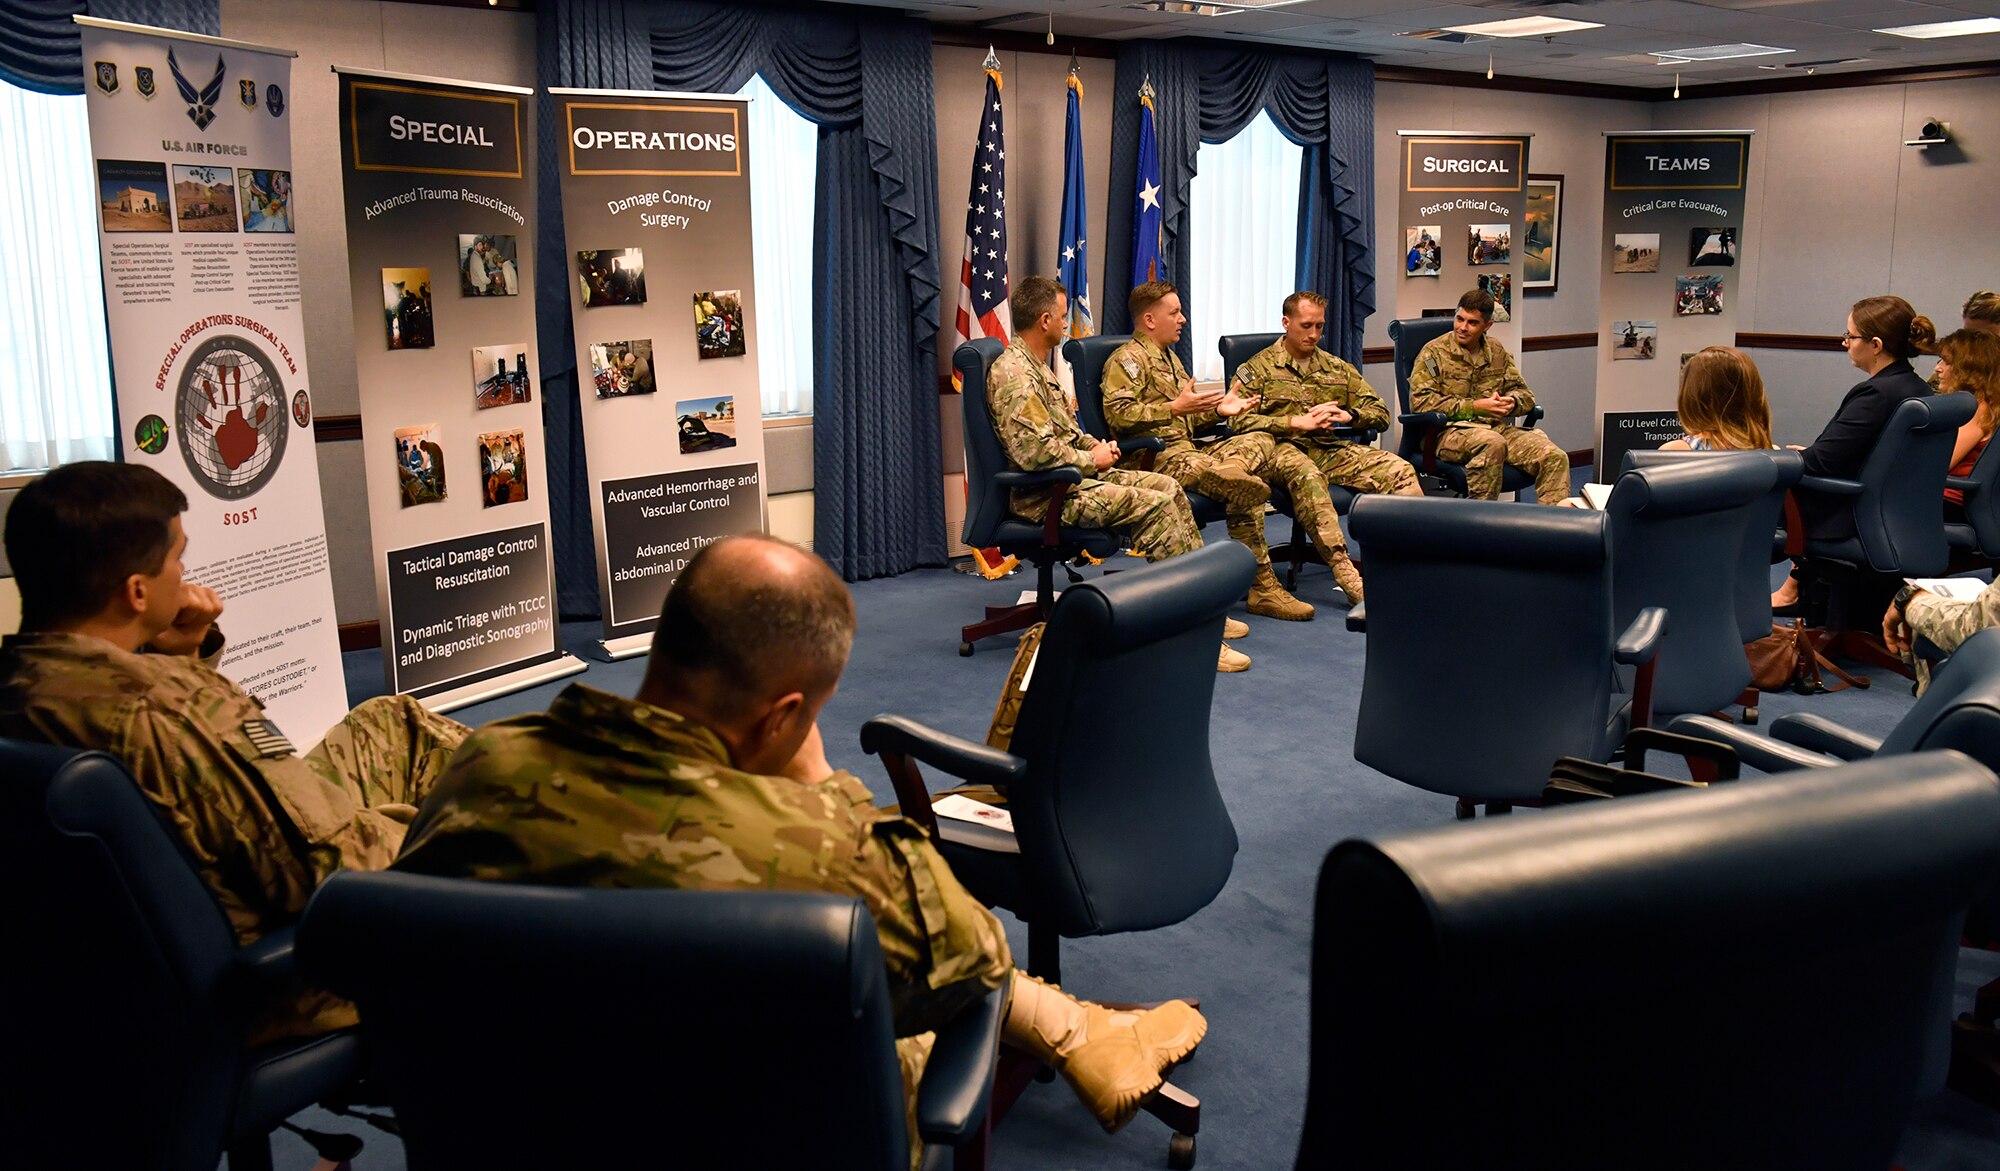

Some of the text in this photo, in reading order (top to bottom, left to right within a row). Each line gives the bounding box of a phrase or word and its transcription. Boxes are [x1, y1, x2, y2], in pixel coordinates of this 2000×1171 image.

[390, 115, 493, 147] SPECIAL
[573, 127, 736, 151] OPERATIONS
[162, 140, 248, 156] U.S. AIR FORCE
[1423, 156, 1509, 173] SURGICAL
[1645, 156, 1710, 171] TEAMS
[364, 188, 525, 226] Advanced Trauma Resuscitation
[607, 190, 711, 215] Damage Control
[1420, 198, 1510, 217] Post-op Critical Care
[1623, 199, 1728, 218] Critical Care Evacuation
[640, 213, 689, 229] Surgery
[156, 314, 297, 391] SPECIAL OPERATIONS SURGICAL TEAM
[1620, 420, 1634, 428] ICU
[1636, 419, 1658, 428] Level
[1644, 432, 1685, 441] Transport
[608, 472, 758, 503] Advanced Hemorrhage and
[224, 507, 258, 525] SOST
[641, 494, 730, 518] Vascular Control
[403, 535, 538, 575] Tactical Damage Control
[636, 538, 690, 558] Advanced
[435, 564, 510, 590] Resuscitation
[614, 559, 674, 582] abdominal
[403, 596, 546, 644] Dynamic Triage with TCCC
[226, 640, 250, 654] dedicated
[257, 634, 270, 643] their
[271, 630, 284, 639] craft,
[285, 625, 297, 634] their
[298, 622, 311, 630] team,
[312, 617, 322, 625] their
[401, 616, 549, 666] and Diagnostic Sonography
[222, 655, 243, 668] patients,
[244, 650, 253, 658] and
[264, 640, 285, 651] mission.
[276, 663, 289, 672] SOST
[245, 680, 272, 696] LATORES
[268, 692, 277, 701] the
